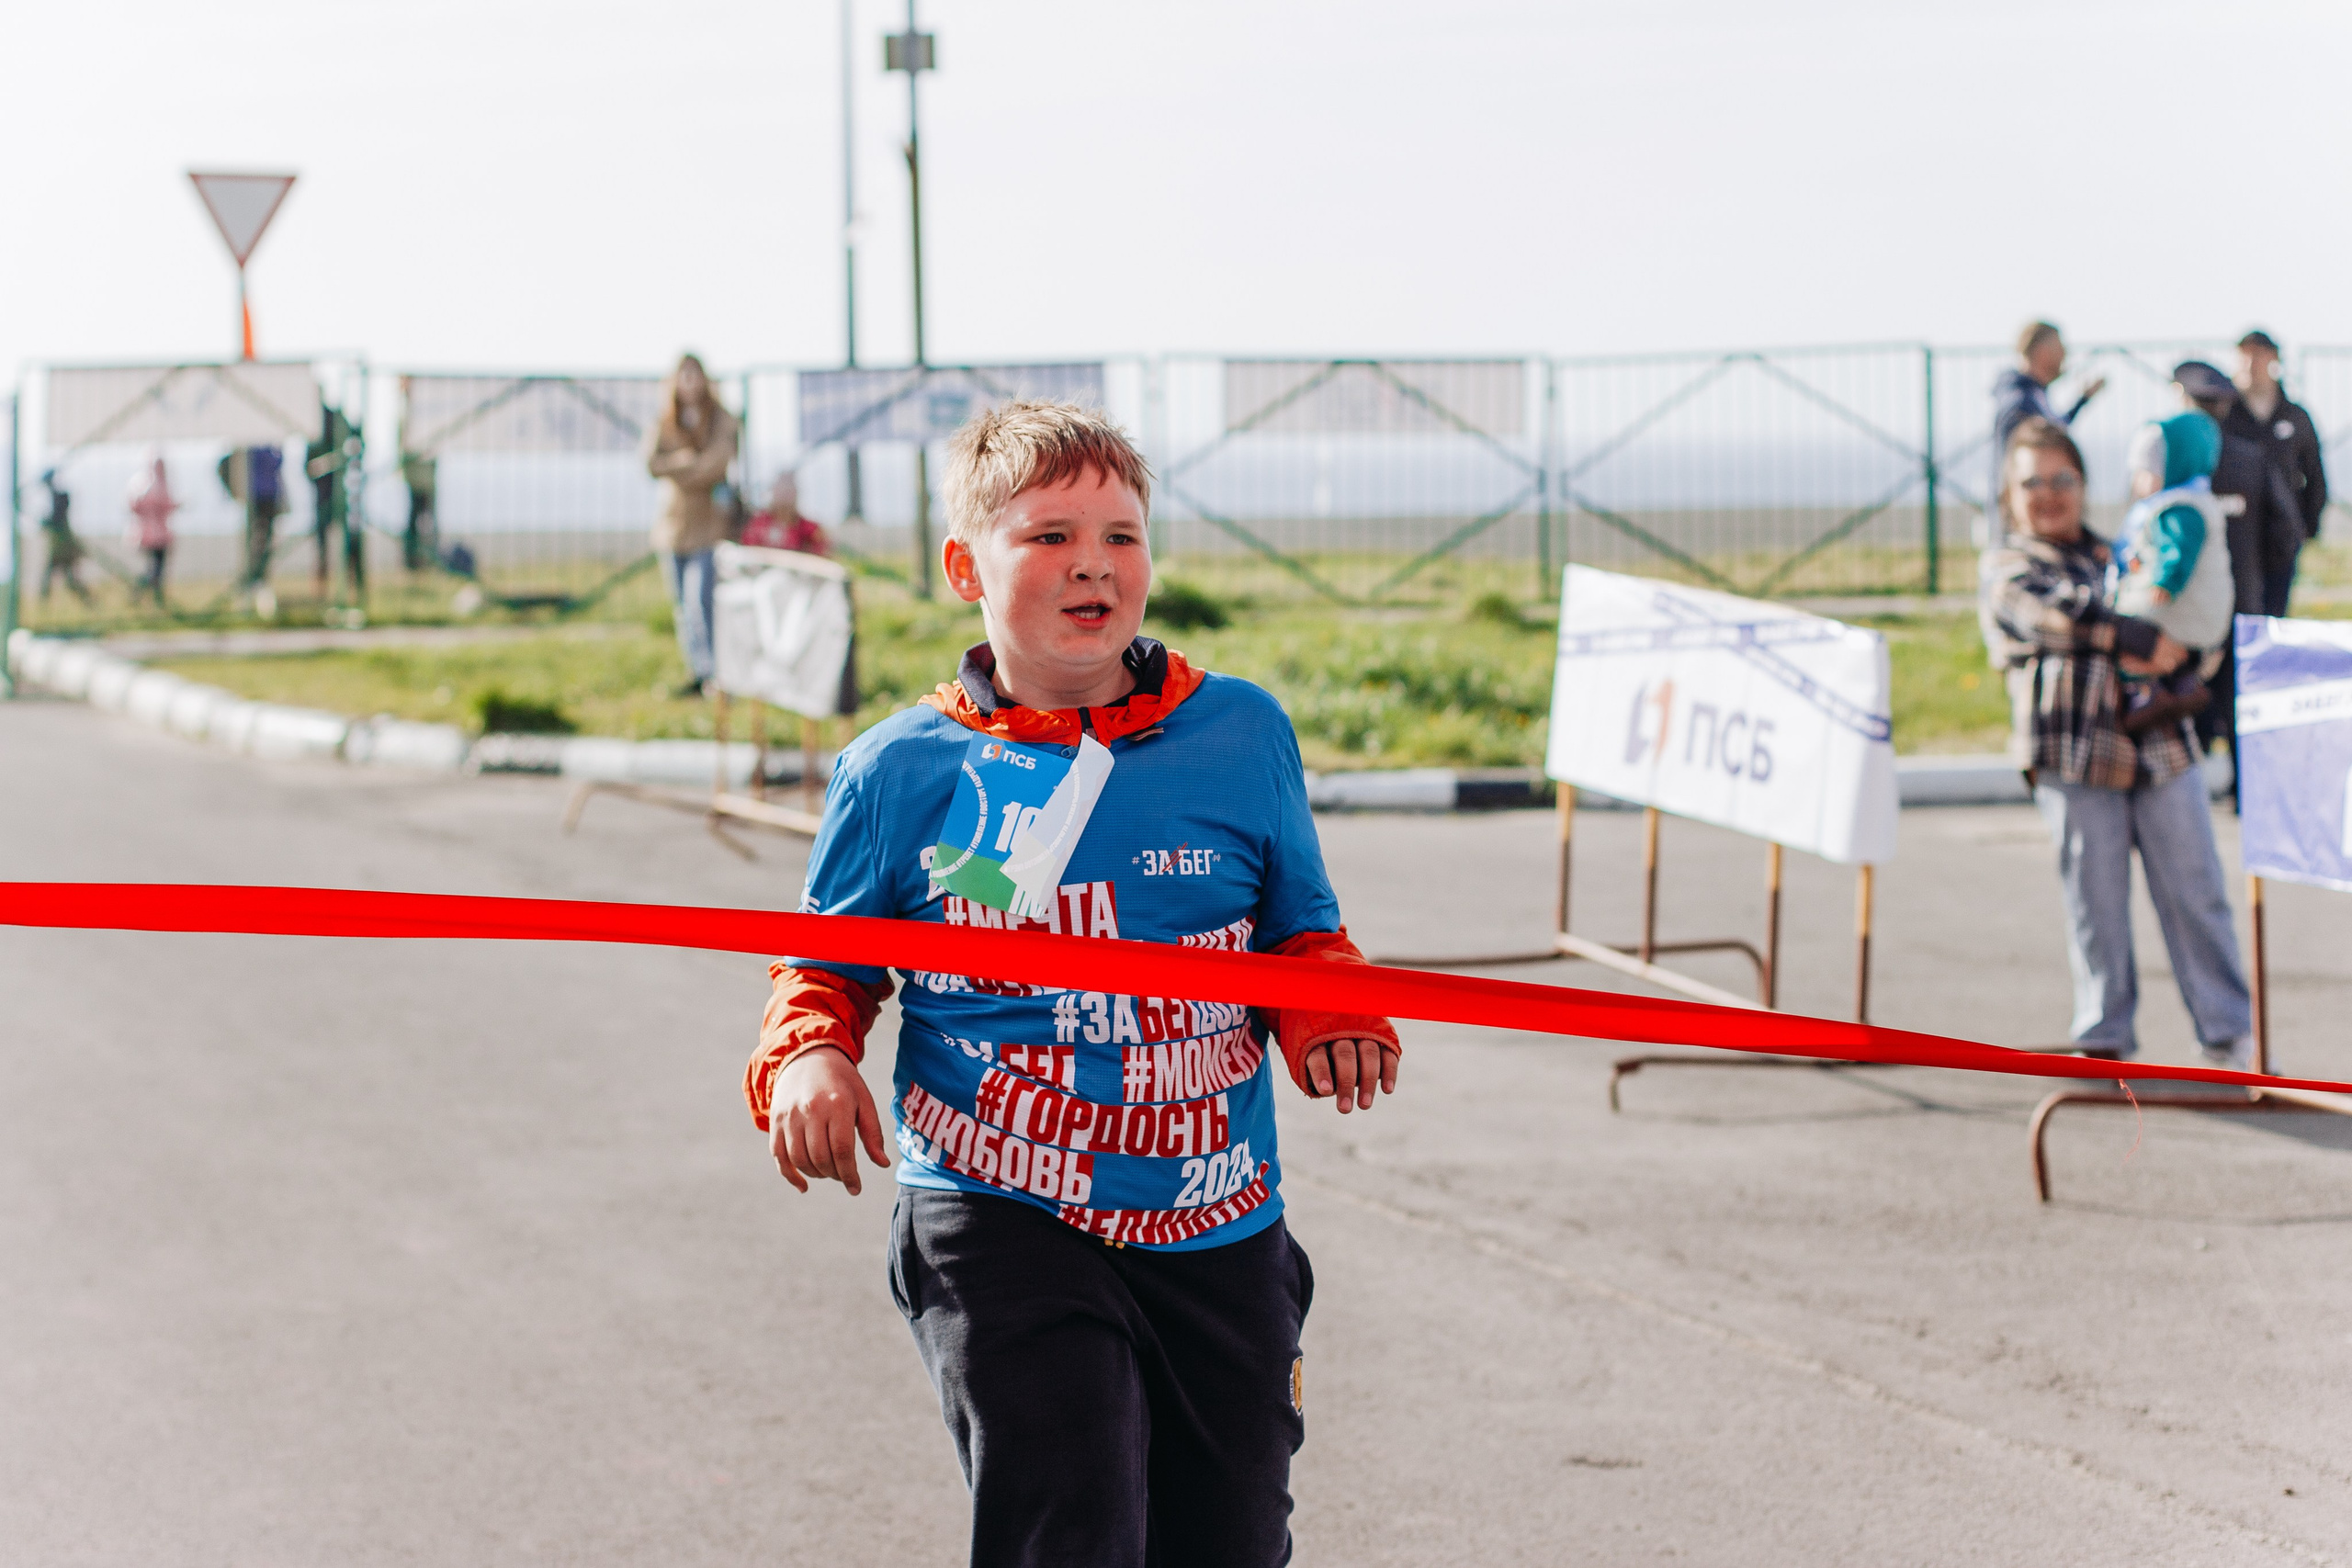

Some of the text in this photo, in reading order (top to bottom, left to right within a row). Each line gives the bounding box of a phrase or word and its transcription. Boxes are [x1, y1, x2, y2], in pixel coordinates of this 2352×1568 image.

[1002, 749, 1037, 771] ПСБ
[1685, 701, 1776, 783] ПСБ
[901, 1080, 1093, 1205] #ЛЮБОВЬ
[977, 1067, 1229, 1158] #ГОРДОСТЬ
[1173, 1137, 1256, 1208] 2024
